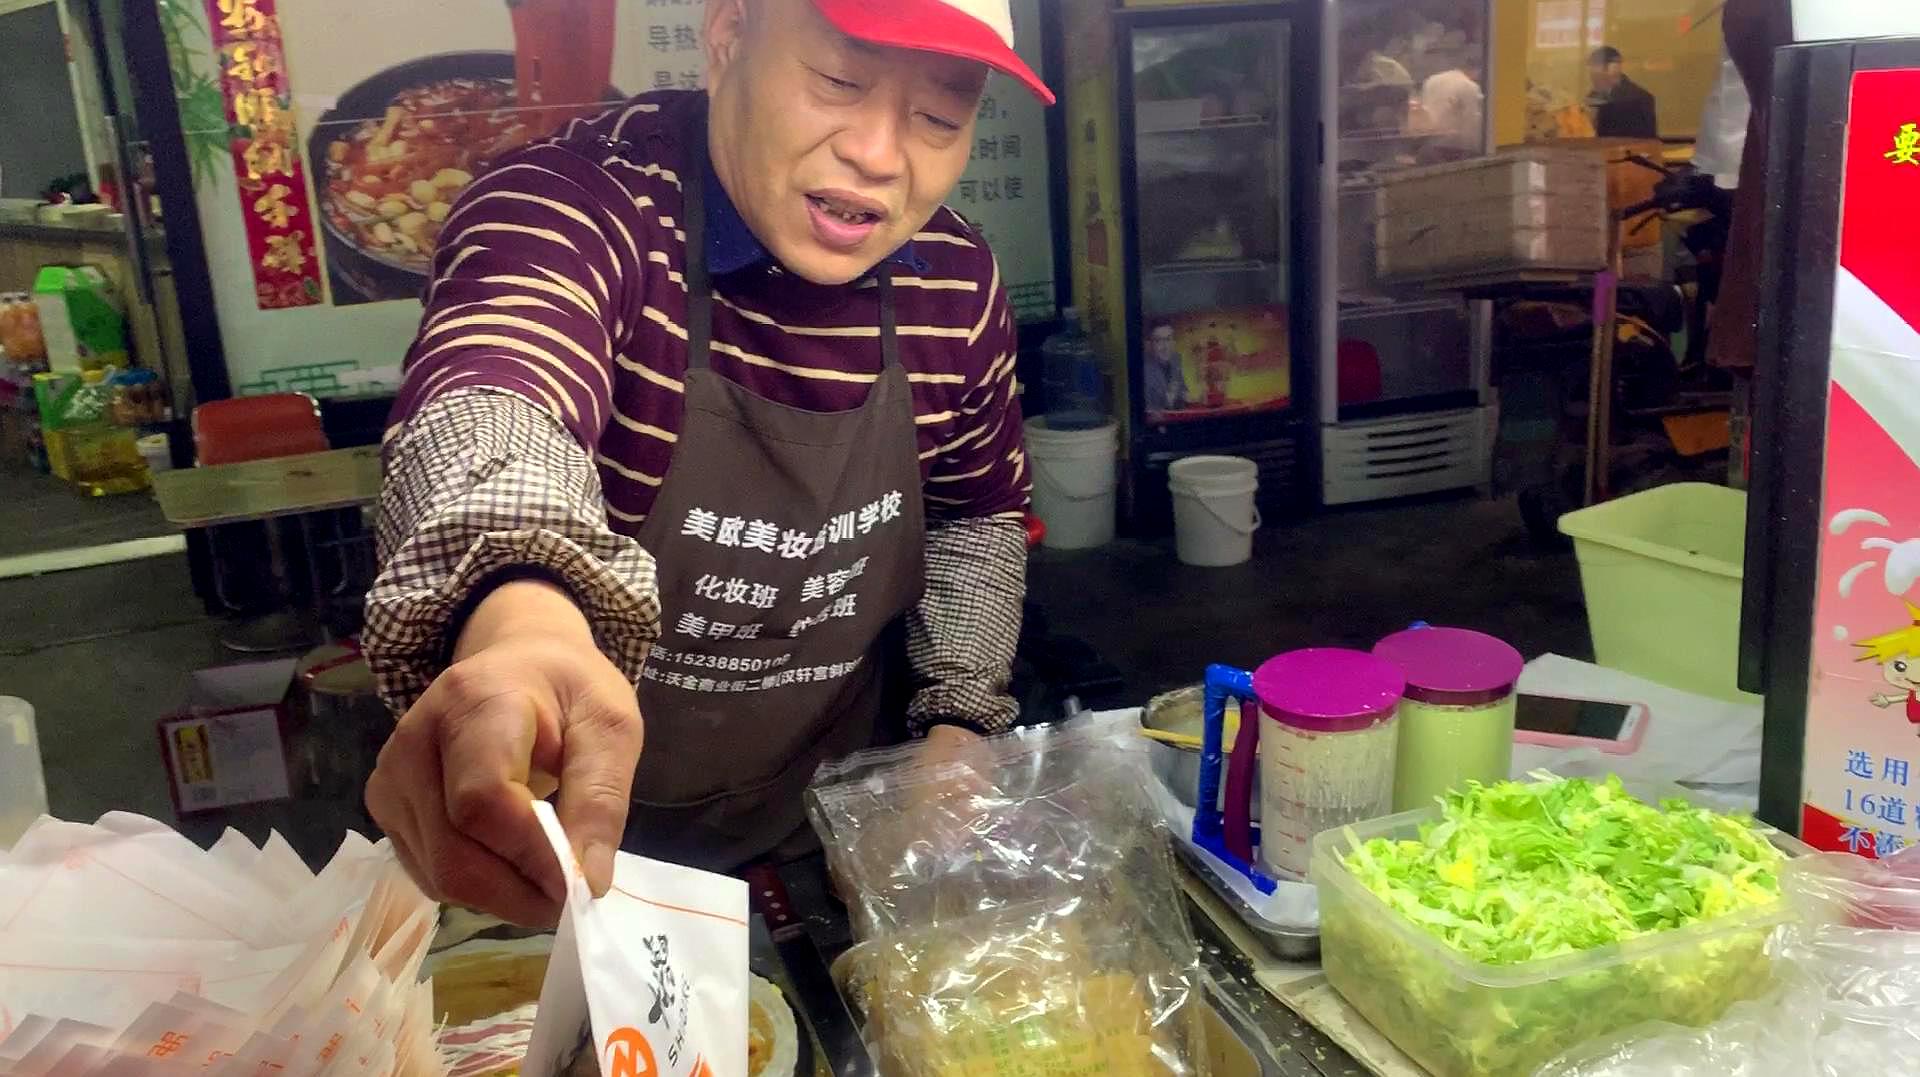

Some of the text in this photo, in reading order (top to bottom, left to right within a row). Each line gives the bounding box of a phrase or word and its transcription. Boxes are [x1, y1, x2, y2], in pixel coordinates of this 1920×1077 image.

[694, 573, 780, 609] 化妆班
[674, 611, 764, 641] 美甲班
[1844, 749, 1909, 787] 选用
